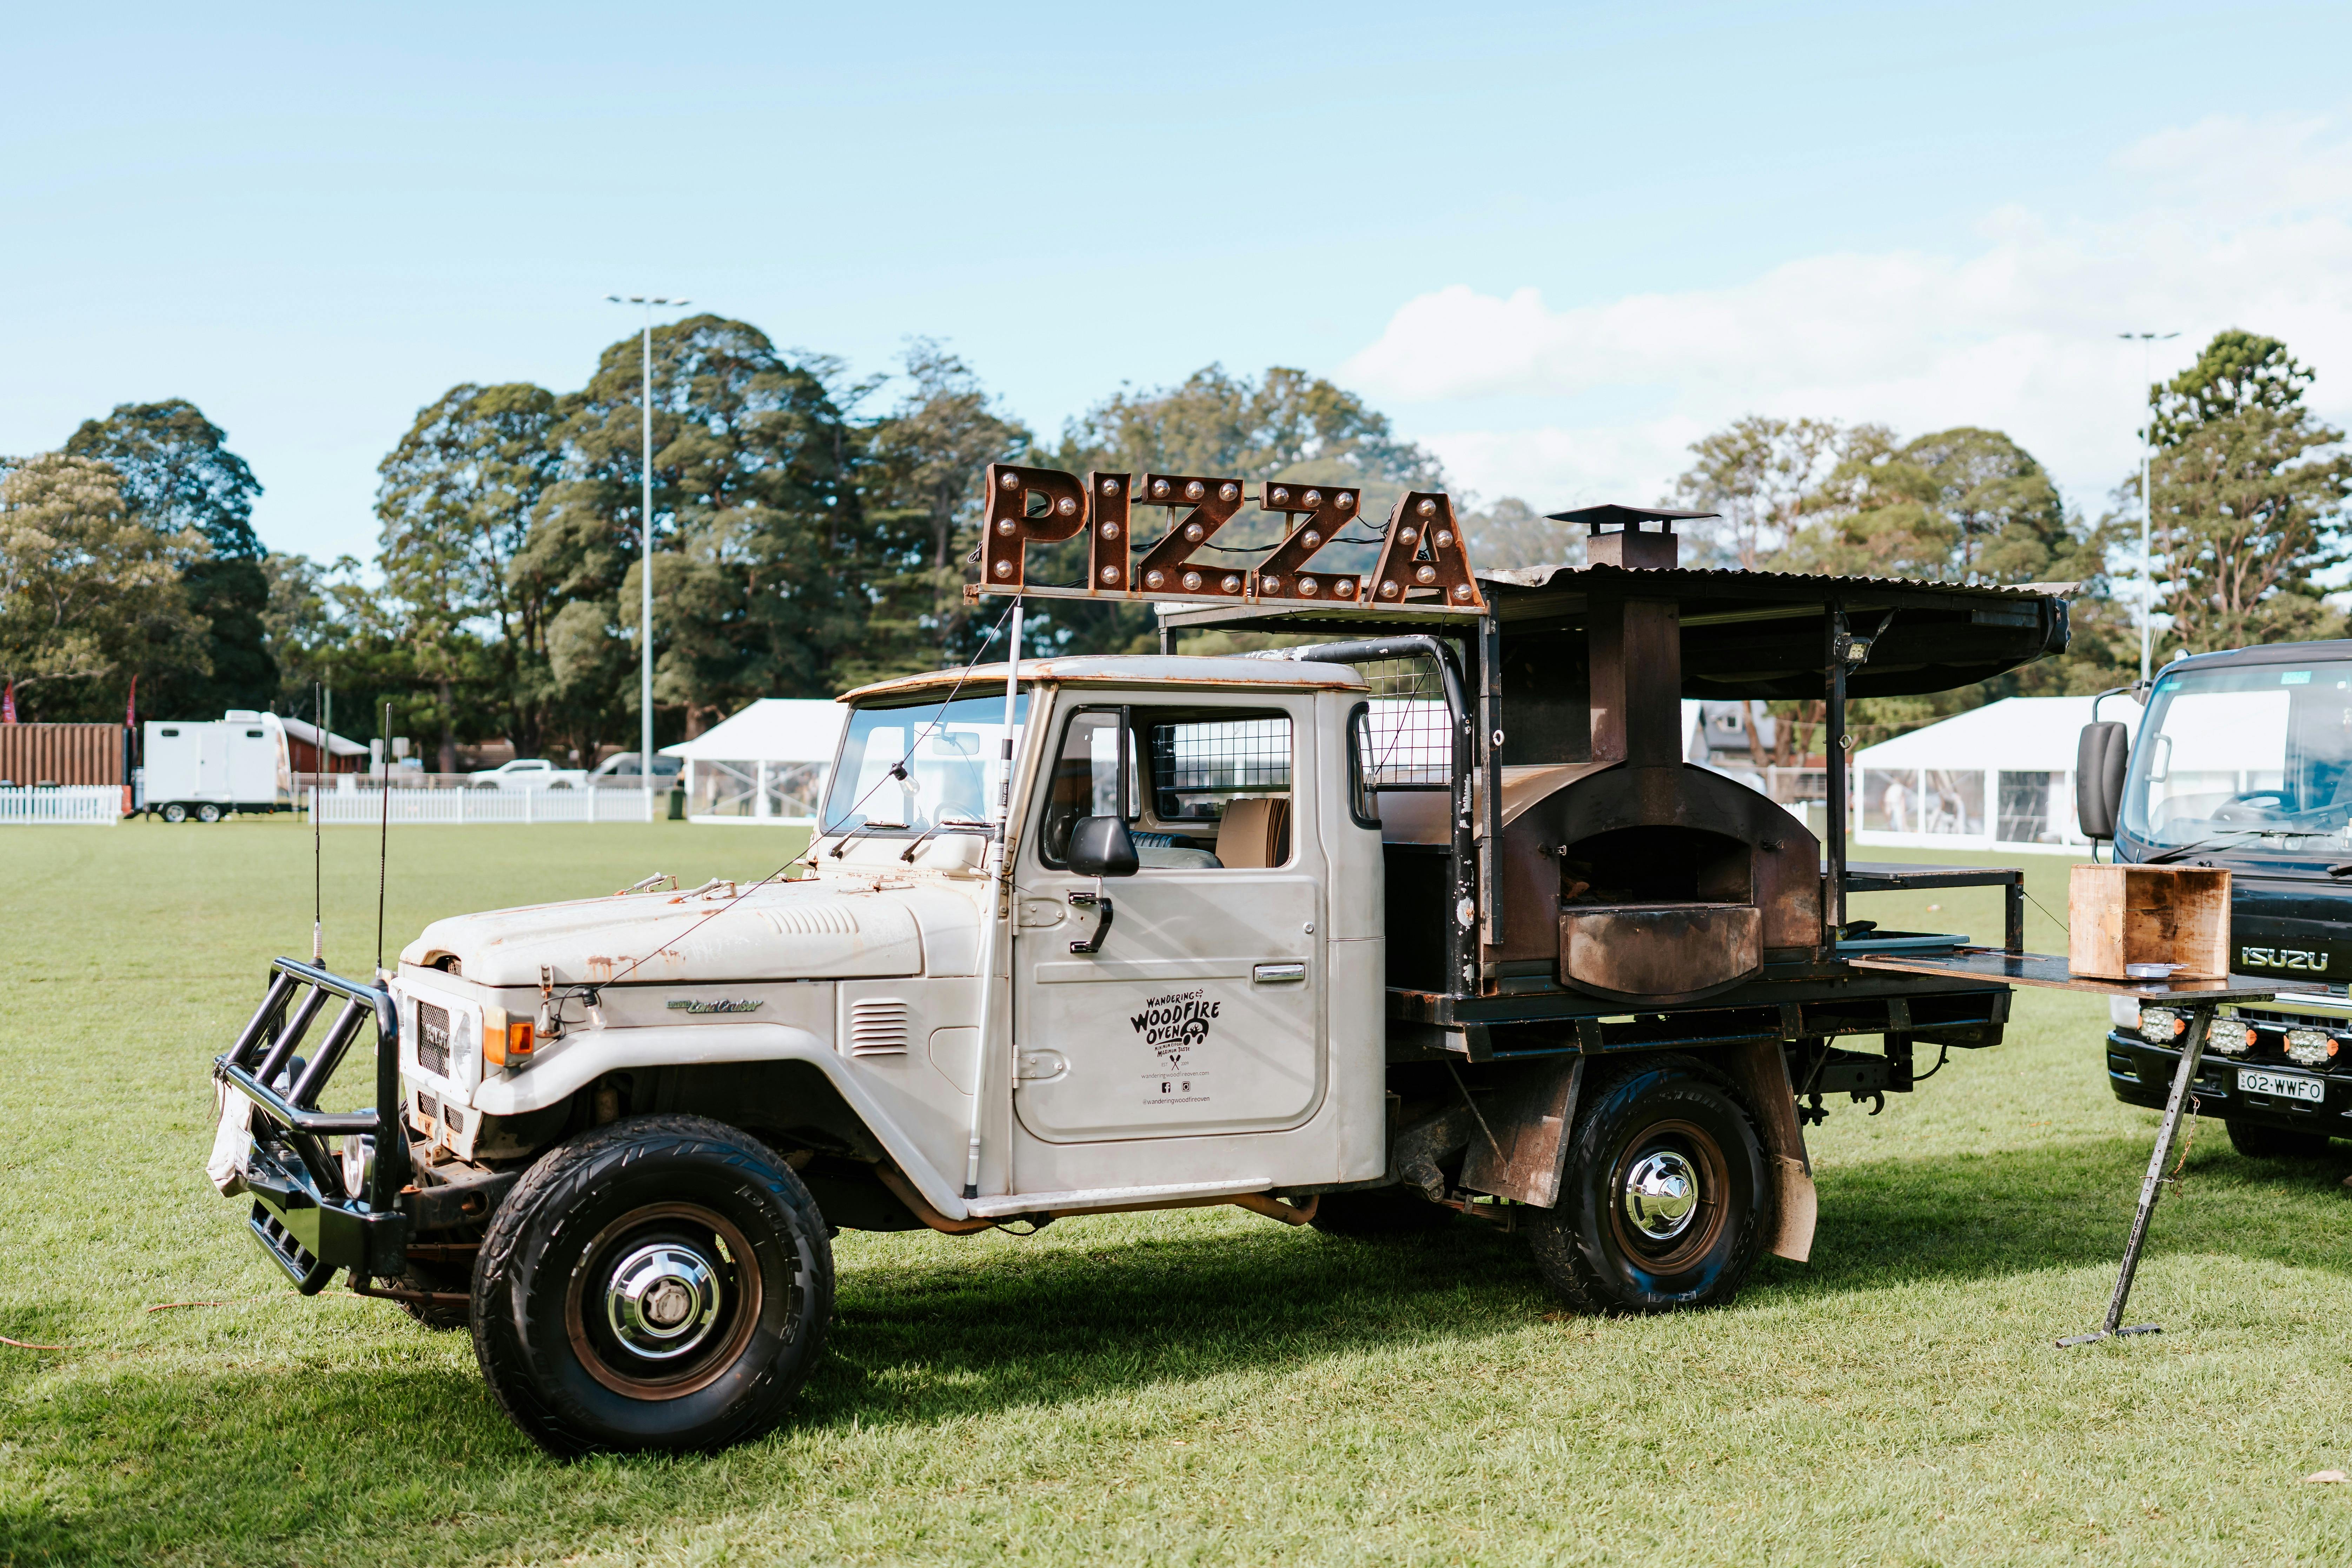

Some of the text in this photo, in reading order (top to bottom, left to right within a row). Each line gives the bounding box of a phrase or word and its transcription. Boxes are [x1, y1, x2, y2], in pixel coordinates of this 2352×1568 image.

[982, 463, 1487, 608] PIZZA
[2242, 947, 2328, 971] ISUZU
[1146, 992, 1194, 1008] WANDERING
[1130, 1000, 1221, 1033] WOODFIRE
[1146, 1025, 1180, 1044] OVEN
[1157, 1048, 1177, 1057] MAXIMUM
[1141, 1071, 1210, 1079] wanderingwoodfireoven.com
[1142, 1096, 1210, 1105] @wanderingwoodfireoven
[733, 1184, 804, 1347] DUELER
